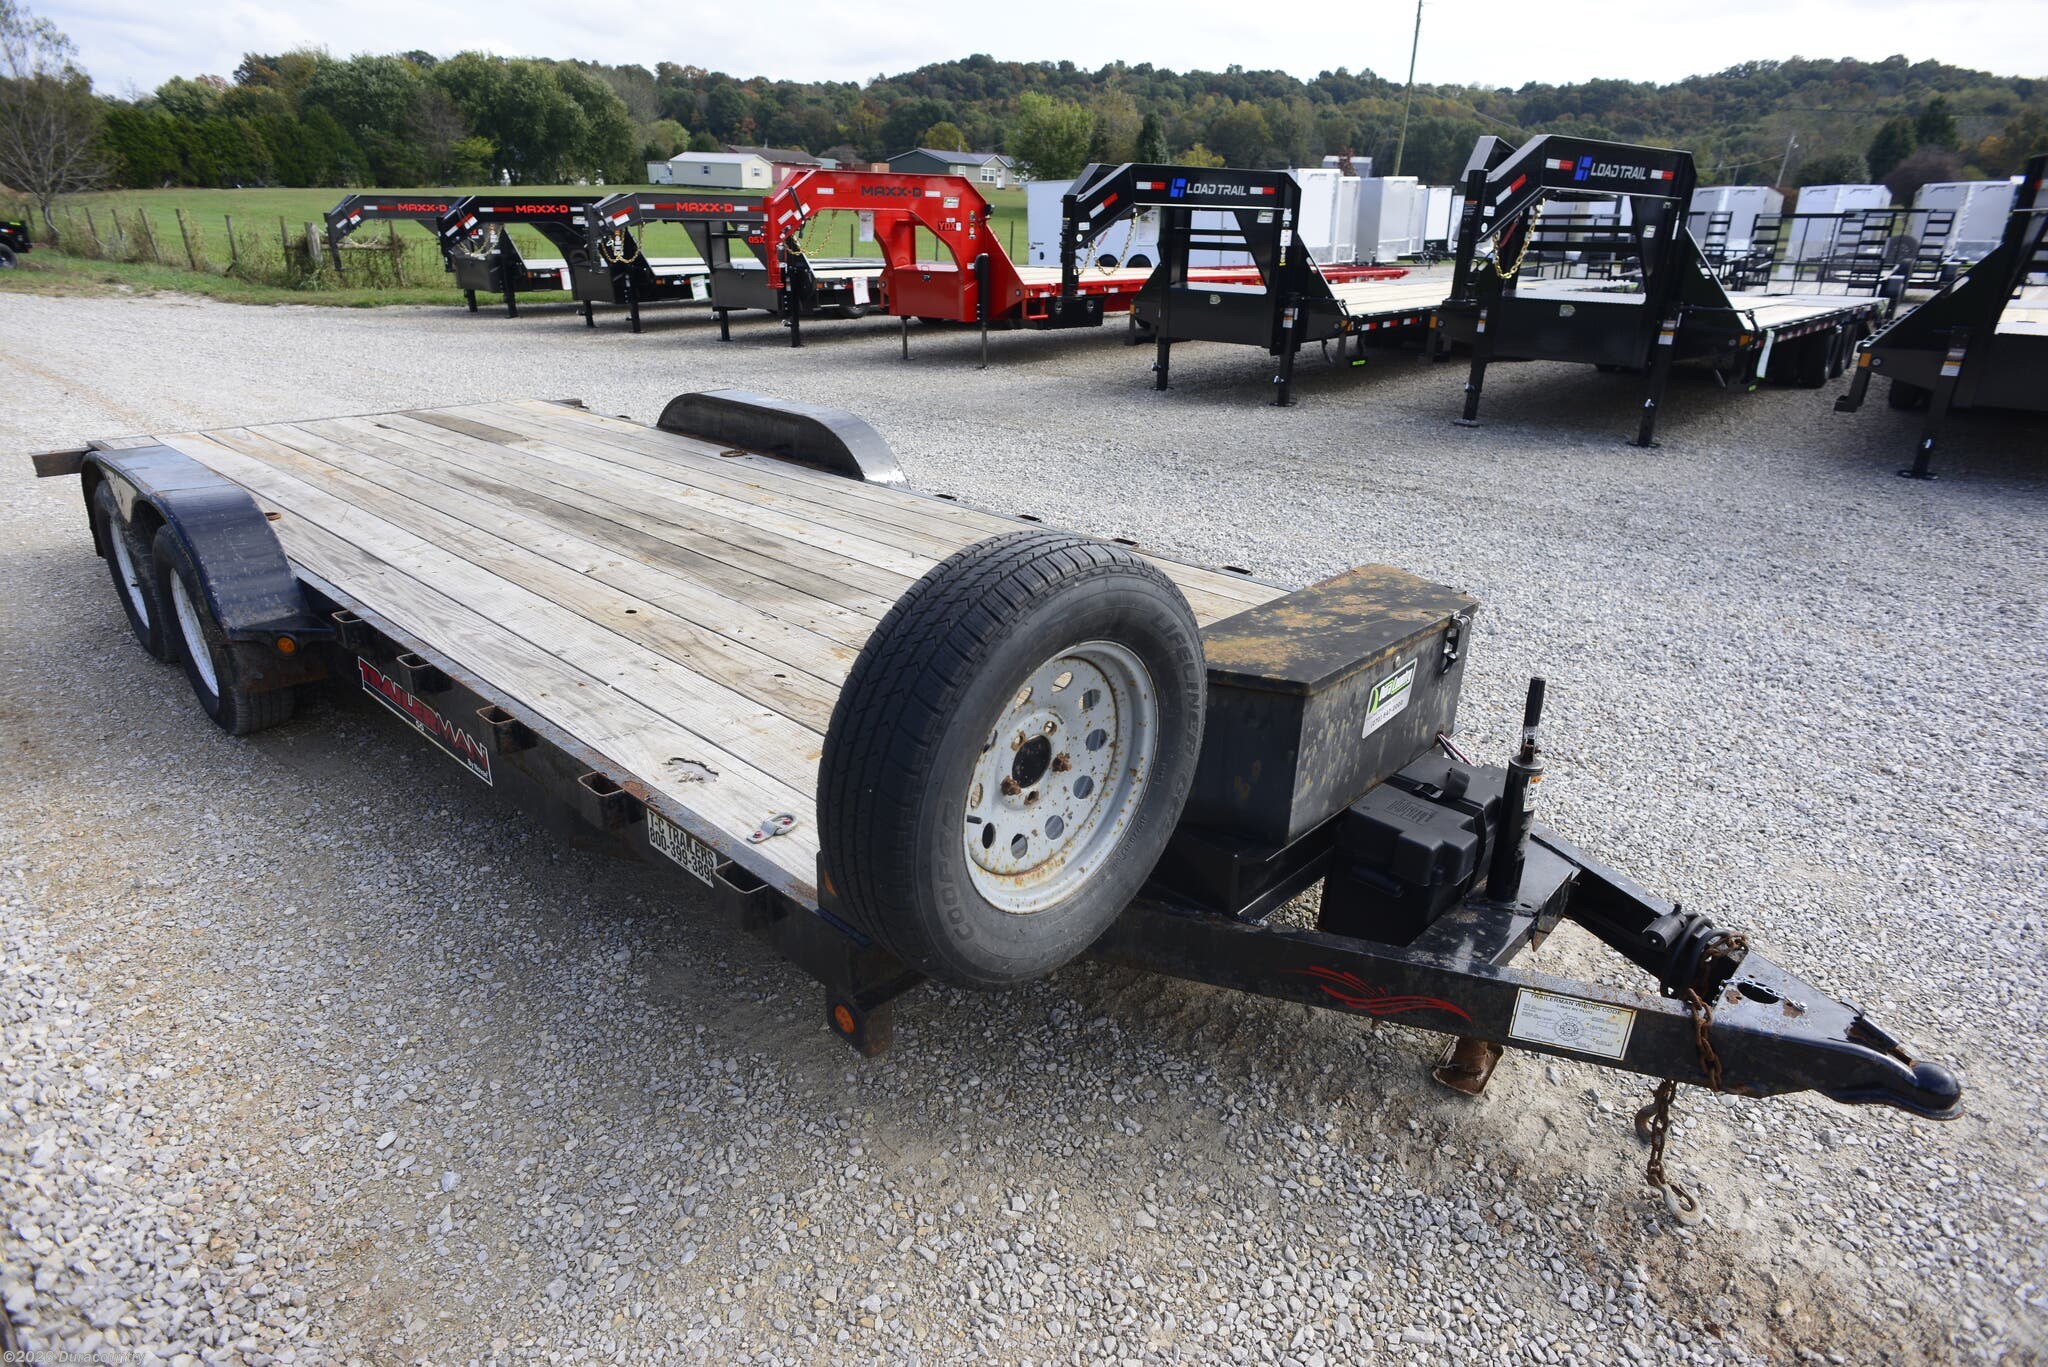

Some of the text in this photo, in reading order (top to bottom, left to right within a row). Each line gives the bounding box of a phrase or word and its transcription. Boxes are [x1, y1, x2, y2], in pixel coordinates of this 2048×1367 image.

[1590, 162, 1647, 180] LOAD TRAIL
[1186, 183, 1247, 196] LOAD TRAIL
[357, 655, 488, 770] TRAILERMAN
[648, 811, 665, 834] T-C
[1530, 993, 1576, 1008] TRAILERMAN
[1601, 1006, 1622, 1016] CODE
